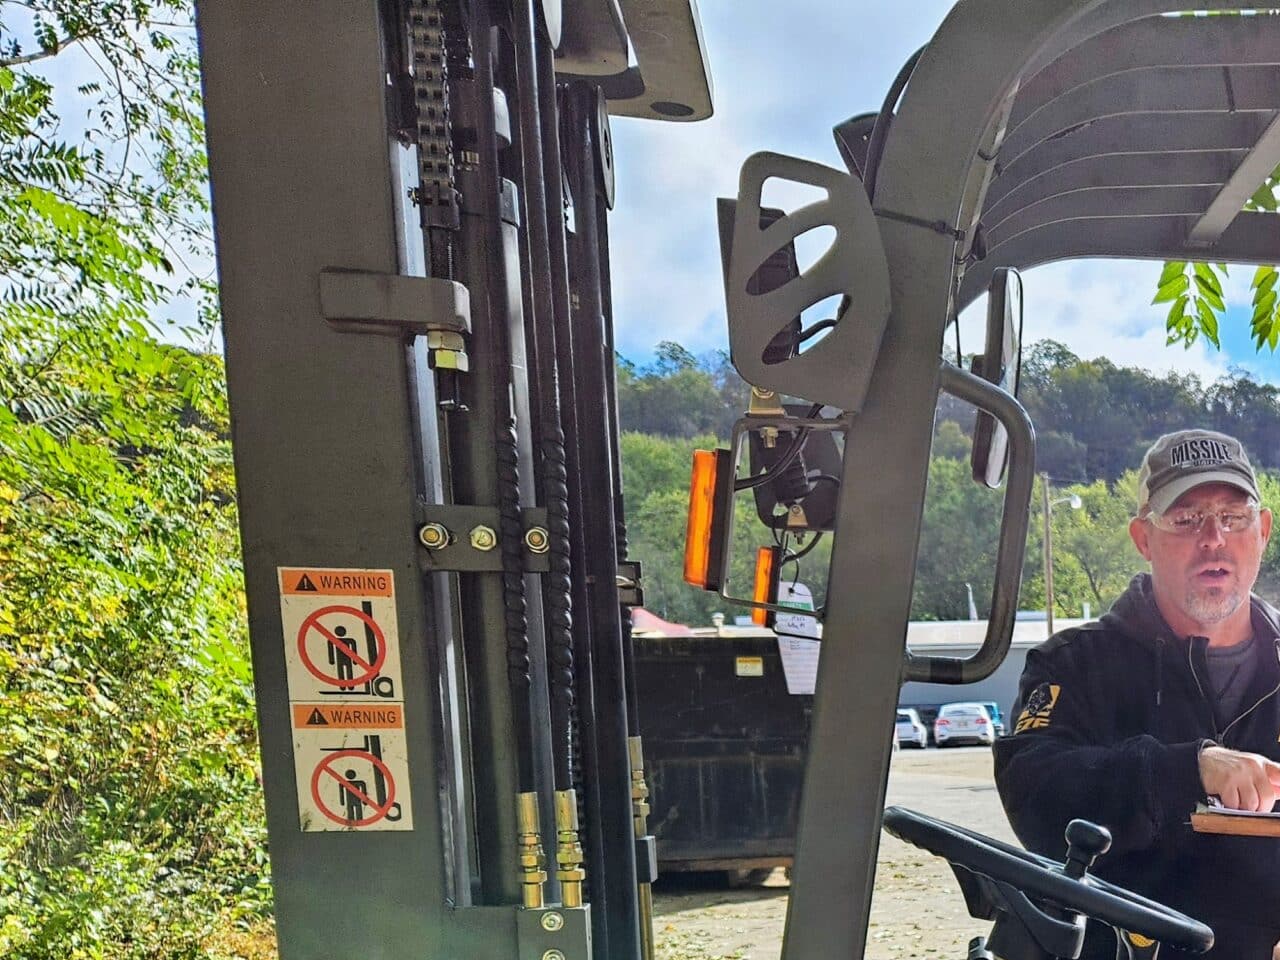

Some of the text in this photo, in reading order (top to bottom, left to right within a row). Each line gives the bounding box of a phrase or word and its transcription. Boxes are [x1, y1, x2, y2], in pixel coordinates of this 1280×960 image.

[1171, 439, 1233, 466] MISSILE
[320, 575, 387, 590] WARNING
[330, 710, 397, 724] WARNING
